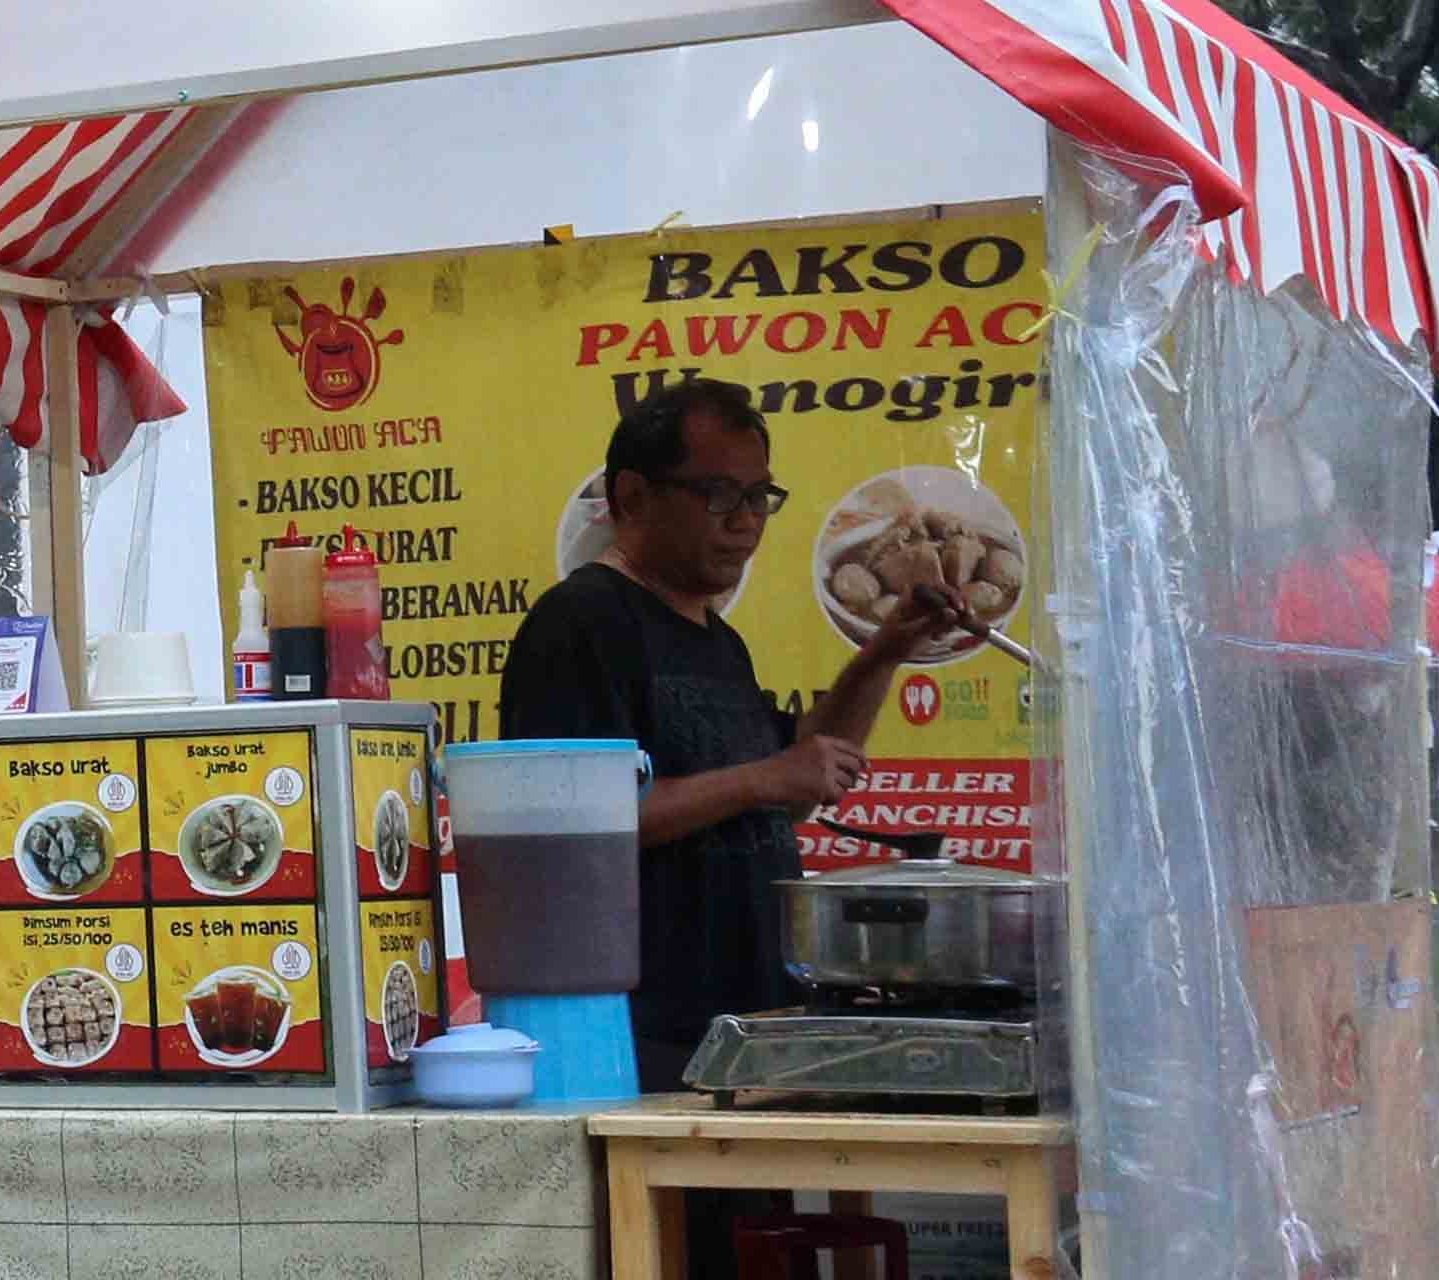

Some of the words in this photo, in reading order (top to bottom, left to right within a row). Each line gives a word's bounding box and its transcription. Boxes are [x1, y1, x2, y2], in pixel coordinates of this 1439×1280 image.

[642, 235, 1026, 303] BAKSO
[575, 307, 891, 367] PAWON
[260, 423, 366, 455] PAWON
[374, 416, 443, 449] ACA
[255, 474, 359, 514] BAKSO
[367, 467, 462, 508] KECIL
[374, 526, 458, 565] URAT
[380, 578, 530, 620] BERANAK
[382, 639, 515, 679] LOBSTE
[9, 760, 64, 778] Bakso
[70, 757, 111, 775] urat
[187, 744, 230, 758] Bakso
[234, 741, 266, 756] urat
[23, 915, 71, 929] Dimsum
[75, 914, 111, 928] Porsi
[44, 932, 113, 947] 25/50/100
[170, 921, 194, 937] es
[199, 919, 234, 938] teh
[241, 919, 299, 936] manis
